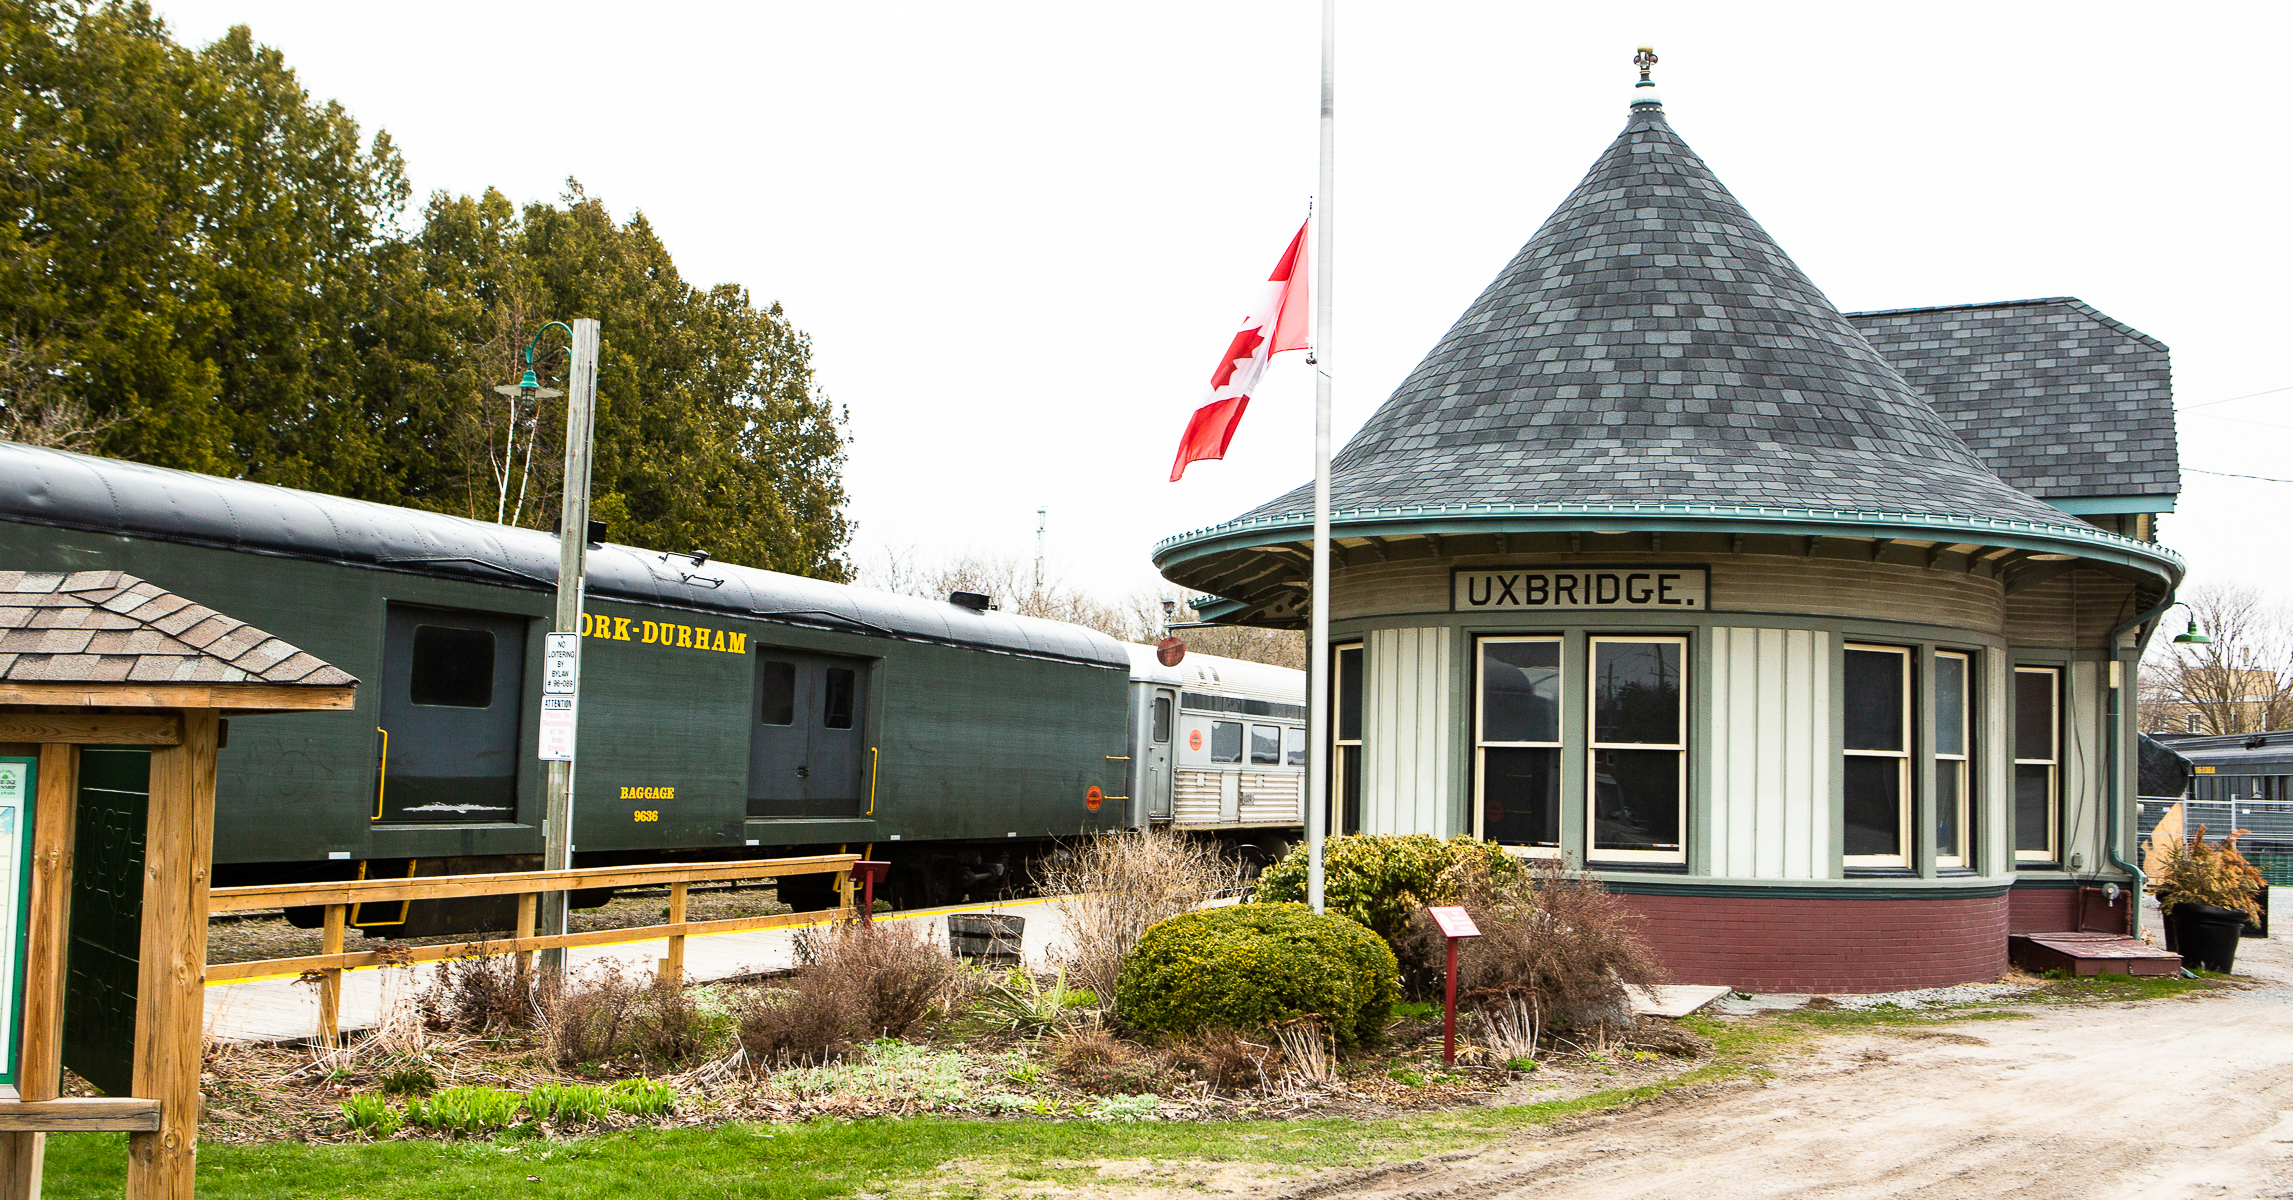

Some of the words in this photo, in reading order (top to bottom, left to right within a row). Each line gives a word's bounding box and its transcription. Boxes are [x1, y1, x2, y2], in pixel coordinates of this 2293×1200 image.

[1468, 573, 1695, 606] UXBRIDGE.
[581, 612, 748, 655] ORK-DURHAM
[557, 640, 566, 648] NO
[548, 650, 575, 658] LOITERING
[557, 660, 564, 668] BY
[551, 670, 569, 678] BYLAW
[545, 699, 572, 708] ATTENTION
[620, 786, 675, 800] BAGGAGE
[633, 810, 659, 823] 9636
